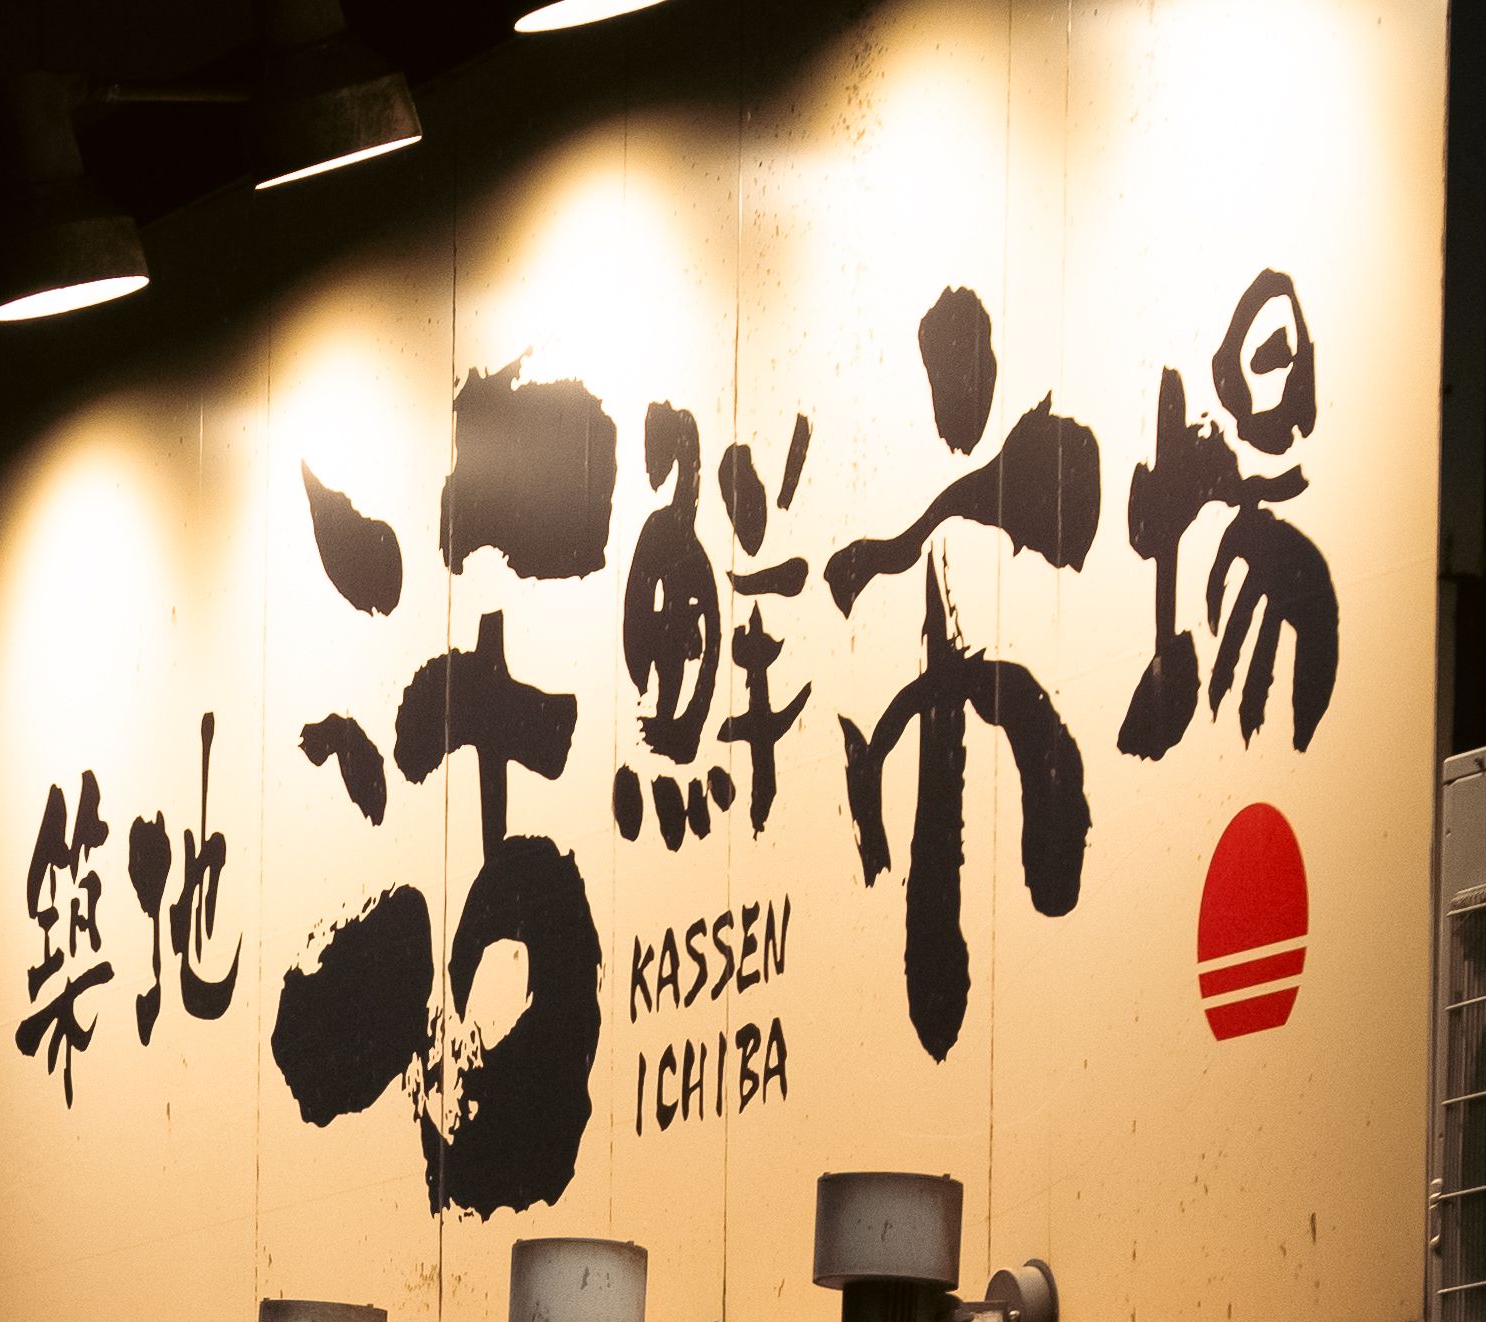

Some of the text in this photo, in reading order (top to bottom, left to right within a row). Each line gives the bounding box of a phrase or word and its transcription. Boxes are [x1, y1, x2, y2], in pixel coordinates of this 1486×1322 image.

[272, 267, 1340, 1221] 活鮮市場
[16, 711, 241, 1108] 築地
[632, 894, 791, 1025] KASSEN
[634, 1017, 789, 1136] ICHIBA
